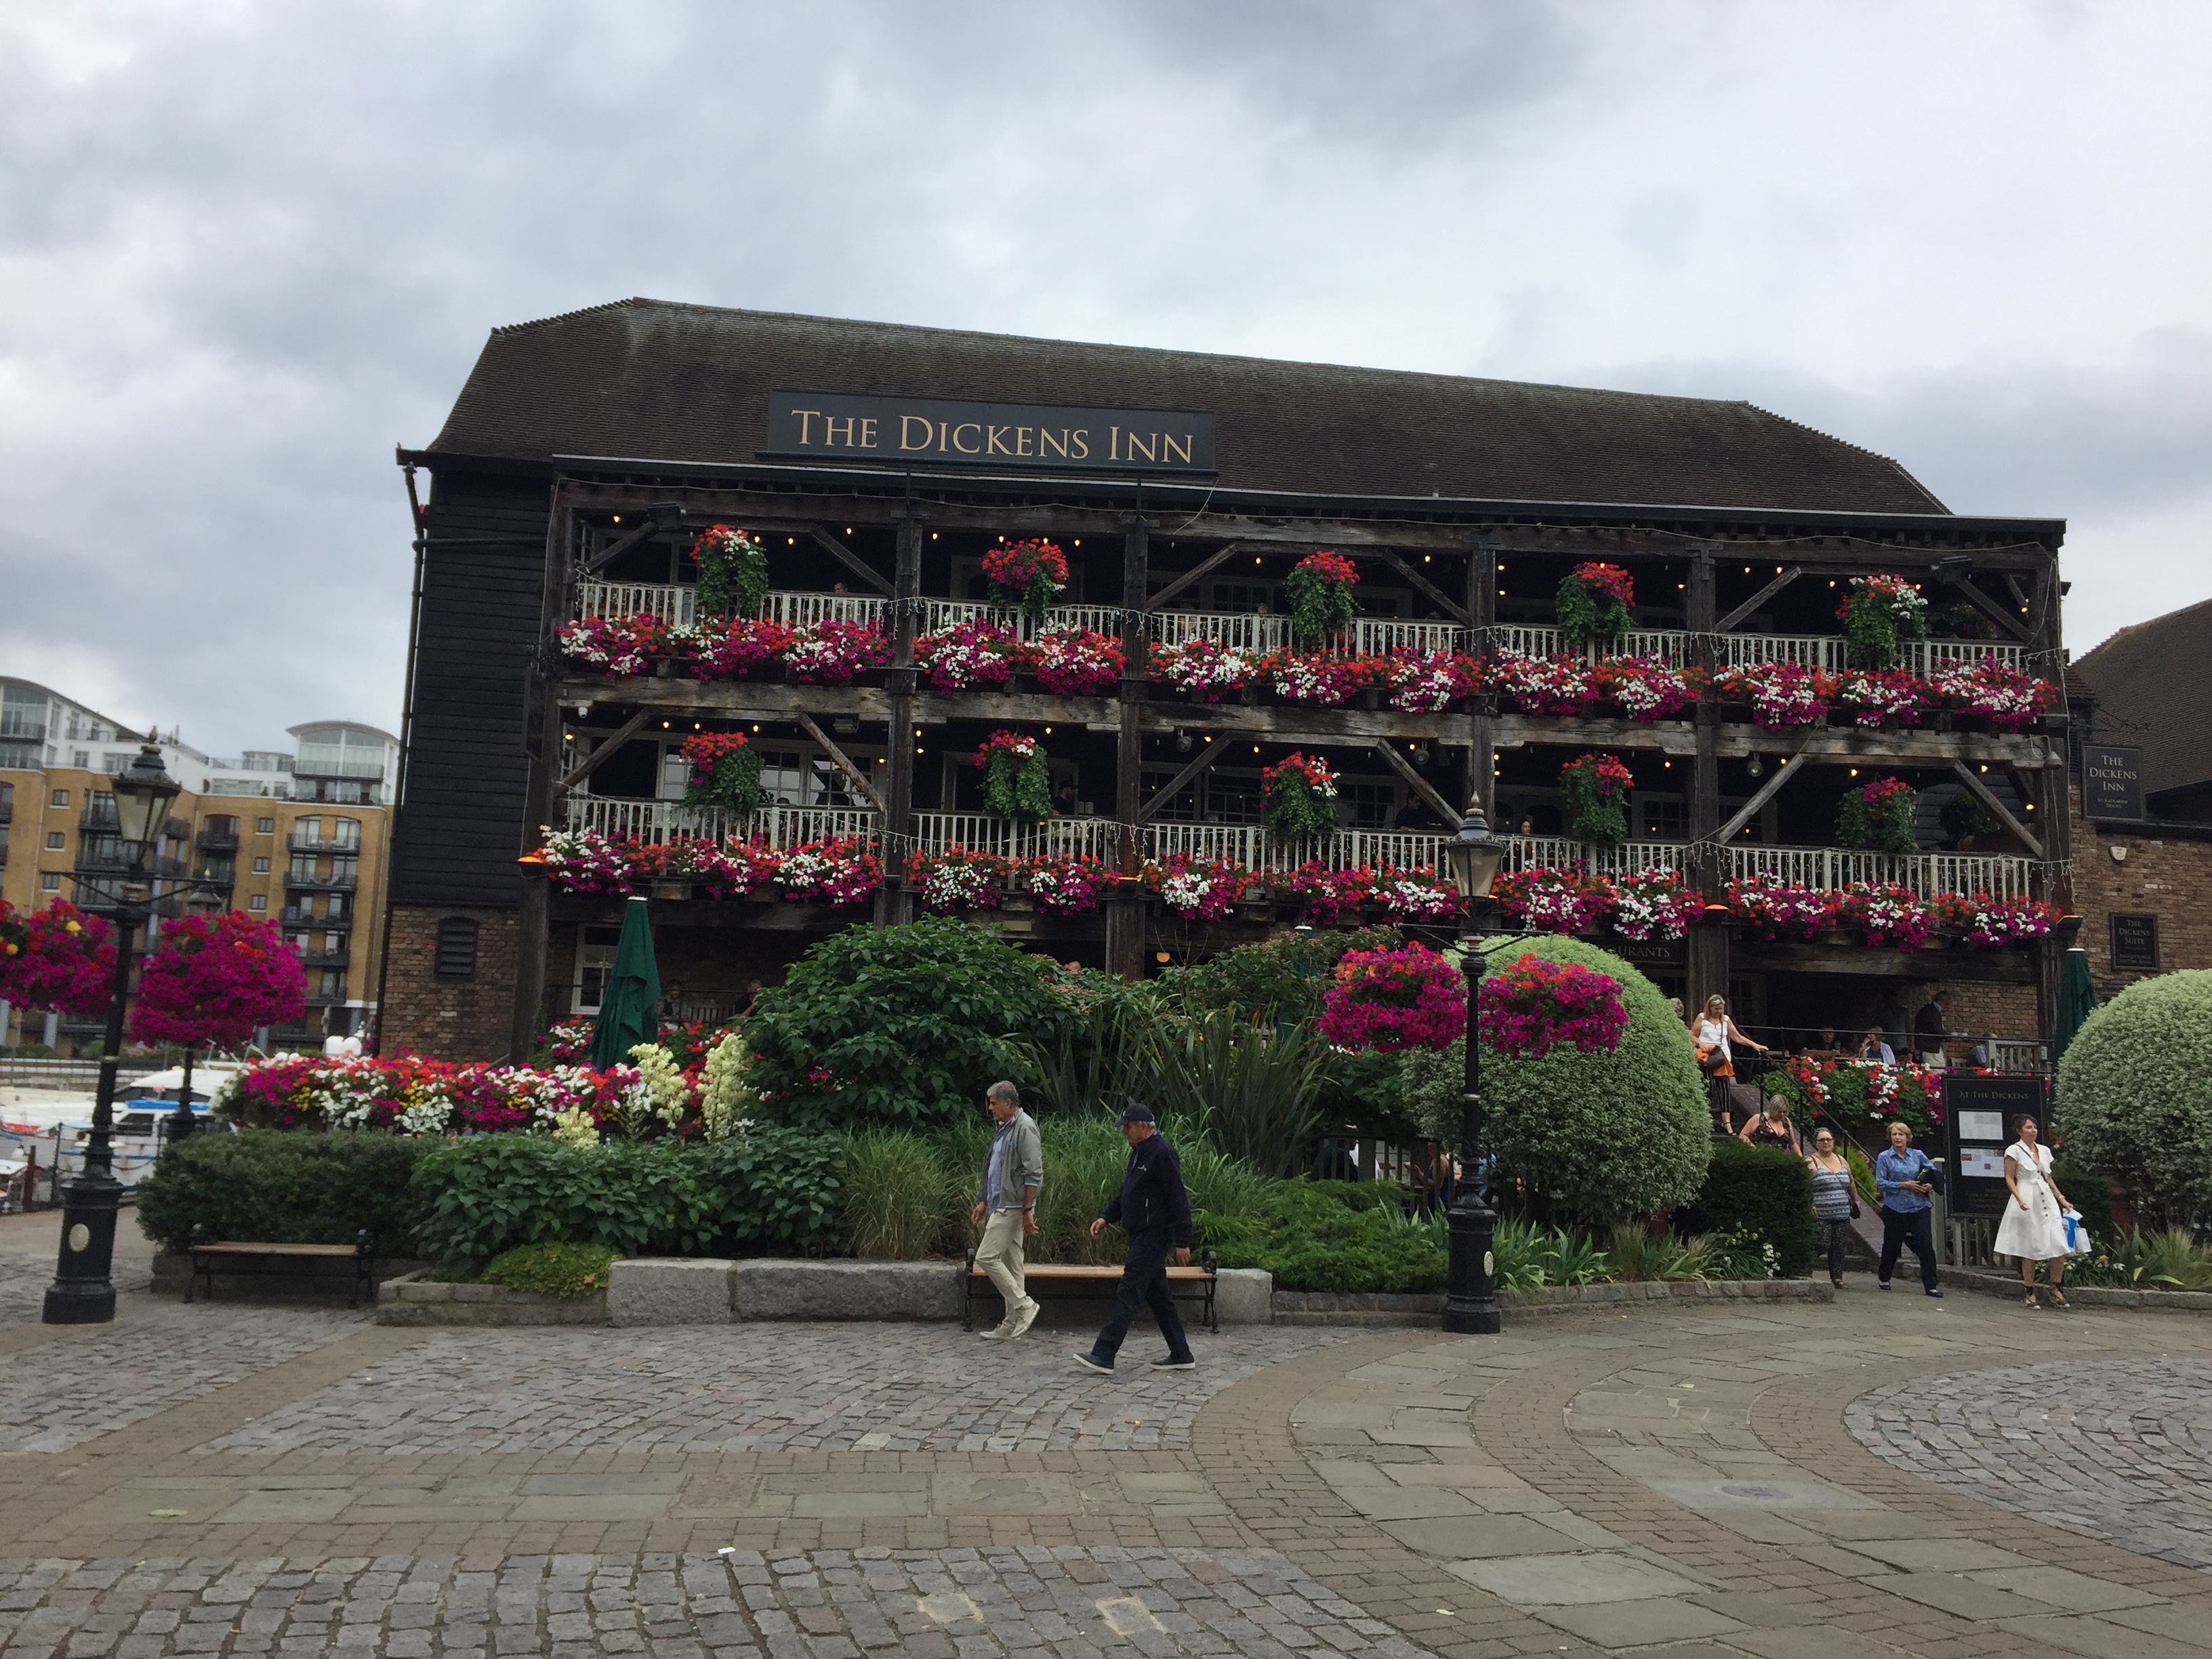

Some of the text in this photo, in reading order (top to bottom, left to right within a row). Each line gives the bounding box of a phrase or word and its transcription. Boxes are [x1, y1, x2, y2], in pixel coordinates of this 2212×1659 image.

[791, 409, 1194, 464] THE DICKENS INN
[2101, 755, 2123, 766] THE
[2089, 767, 2137, 780] DICKENS
[2103, 781, 2125, 792] INN
[2126, 919, 2142, 927] THE
[2118, 927, 2150, 937] DICKENS
[2125, 937, 2145, 945] SUITE
[1971, 1090, 1989, 1099] THE
[1992, 1091, 2029, 1099] DICKENS
